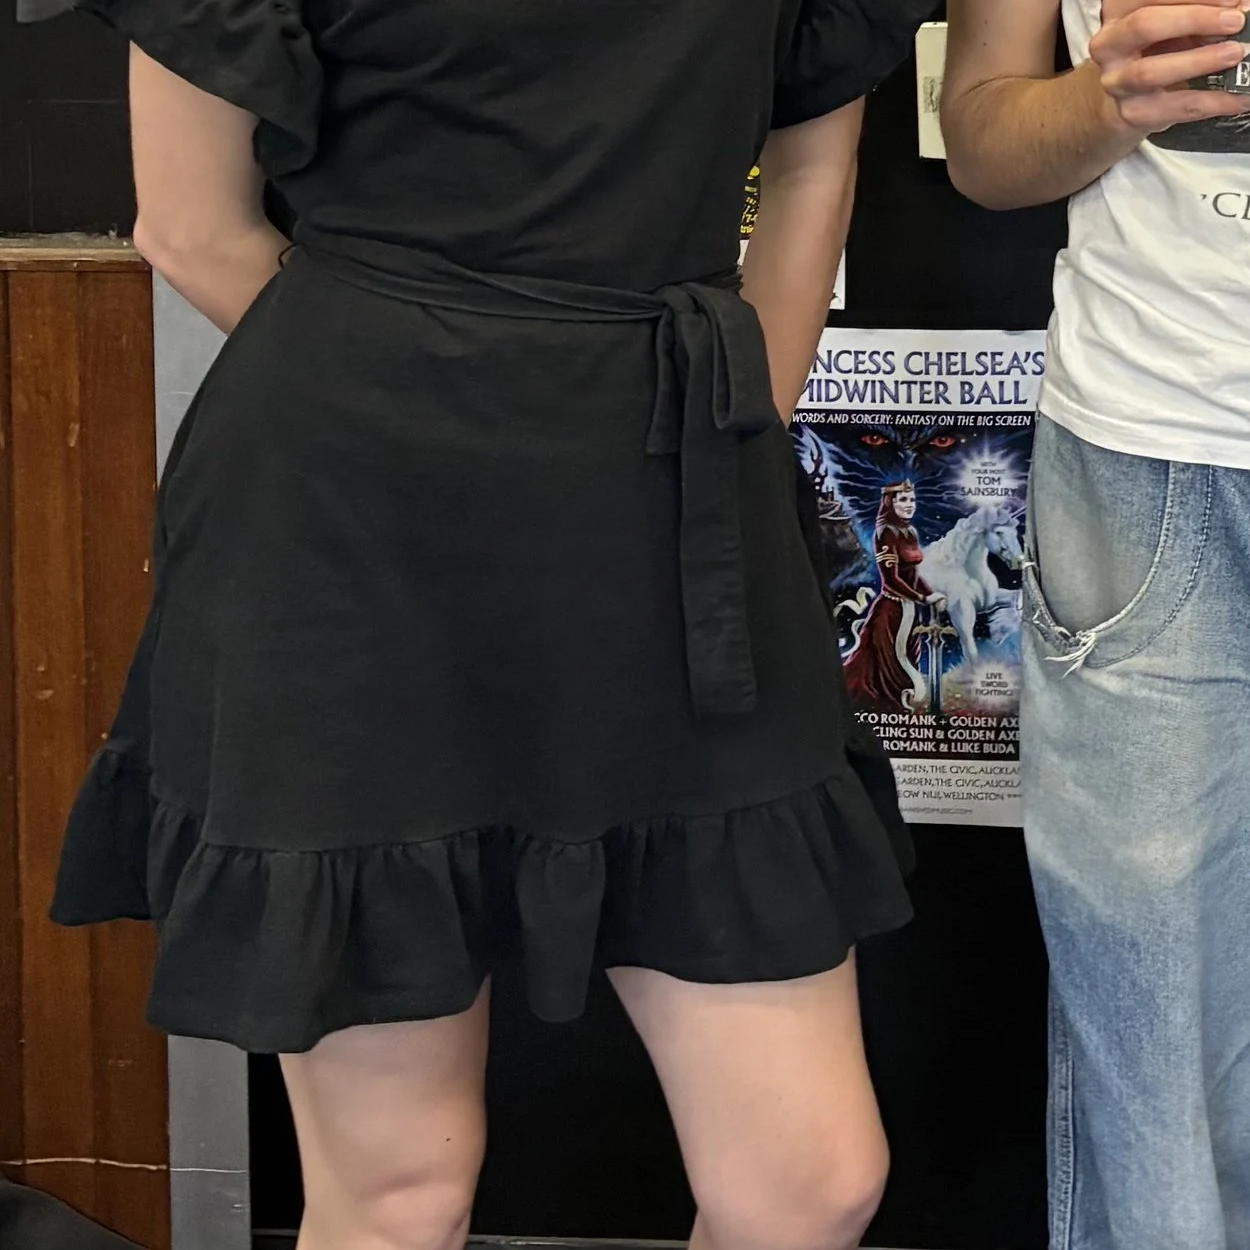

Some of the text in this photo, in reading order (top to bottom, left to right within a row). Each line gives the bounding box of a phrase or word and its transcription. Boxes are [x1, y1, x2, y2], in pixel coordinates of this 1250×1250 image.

[811, 350, 1045, 376] NCESS CHELSEA'S
[960, 380, 1028, 406] BALL
[827, 412, 849, 425] AND
[850, 413, 894, 426] SORCERY:
[895, 414, 938, 426] FANTASY
[939, 415, 955, 426] ON
[956, 415, 974, 426] THE
[976, 415, 993, 426] BIG
[995, 415, 1031, 427] SCREEN
[976, 476, 1001, 486] TOM
[881, 713, 998, 728] ROMANK GOLDEN
[909, 728, 934, 739] SUN
[947, 729, 996, 740] GOLDEN
[883, 740, 937, 753] ROMANK
[951, 742, 981, 754] LUKE
[983, 743, 1016, 754] BUDA
[895, 764, 929, 774] ARDEN,
[929, 765, 945, 774] THE
[900, 777, 934, 787] ARDEN,
[934, 778, 952, 787] THE
